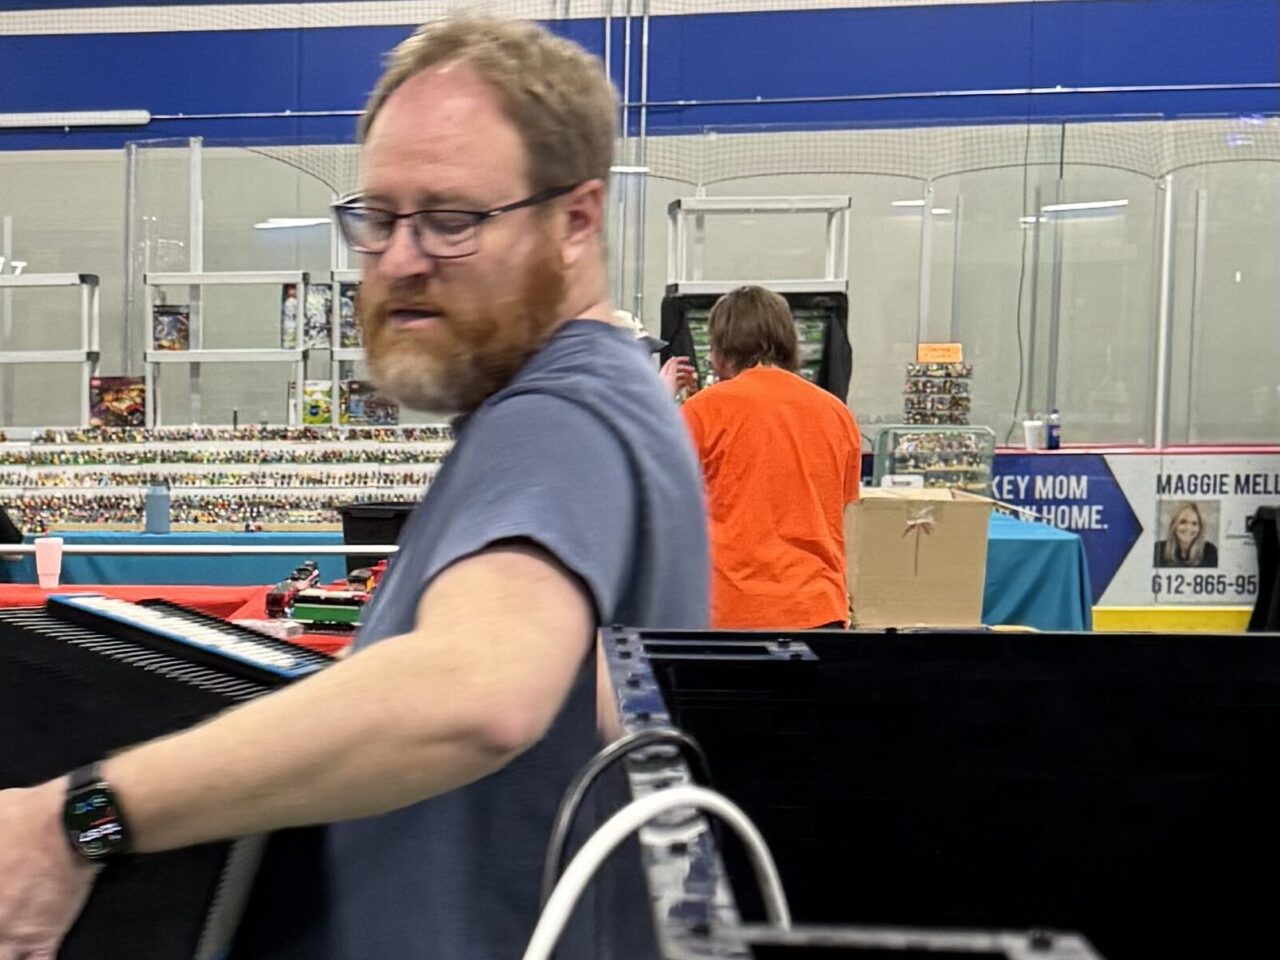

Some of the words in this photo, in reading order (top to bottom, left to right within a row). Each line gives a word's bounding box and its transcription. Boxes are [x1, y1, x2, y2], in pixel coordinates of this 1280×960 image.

[992, 475, 1030, 499] KEY
[1034, 475, 1088, 499] MOM
[1156, 474, 1230, 495] MAGGIE
[1042, 505, 1109, 529] HOME.
[1151, 574, 1257, 595] 612-865-95
